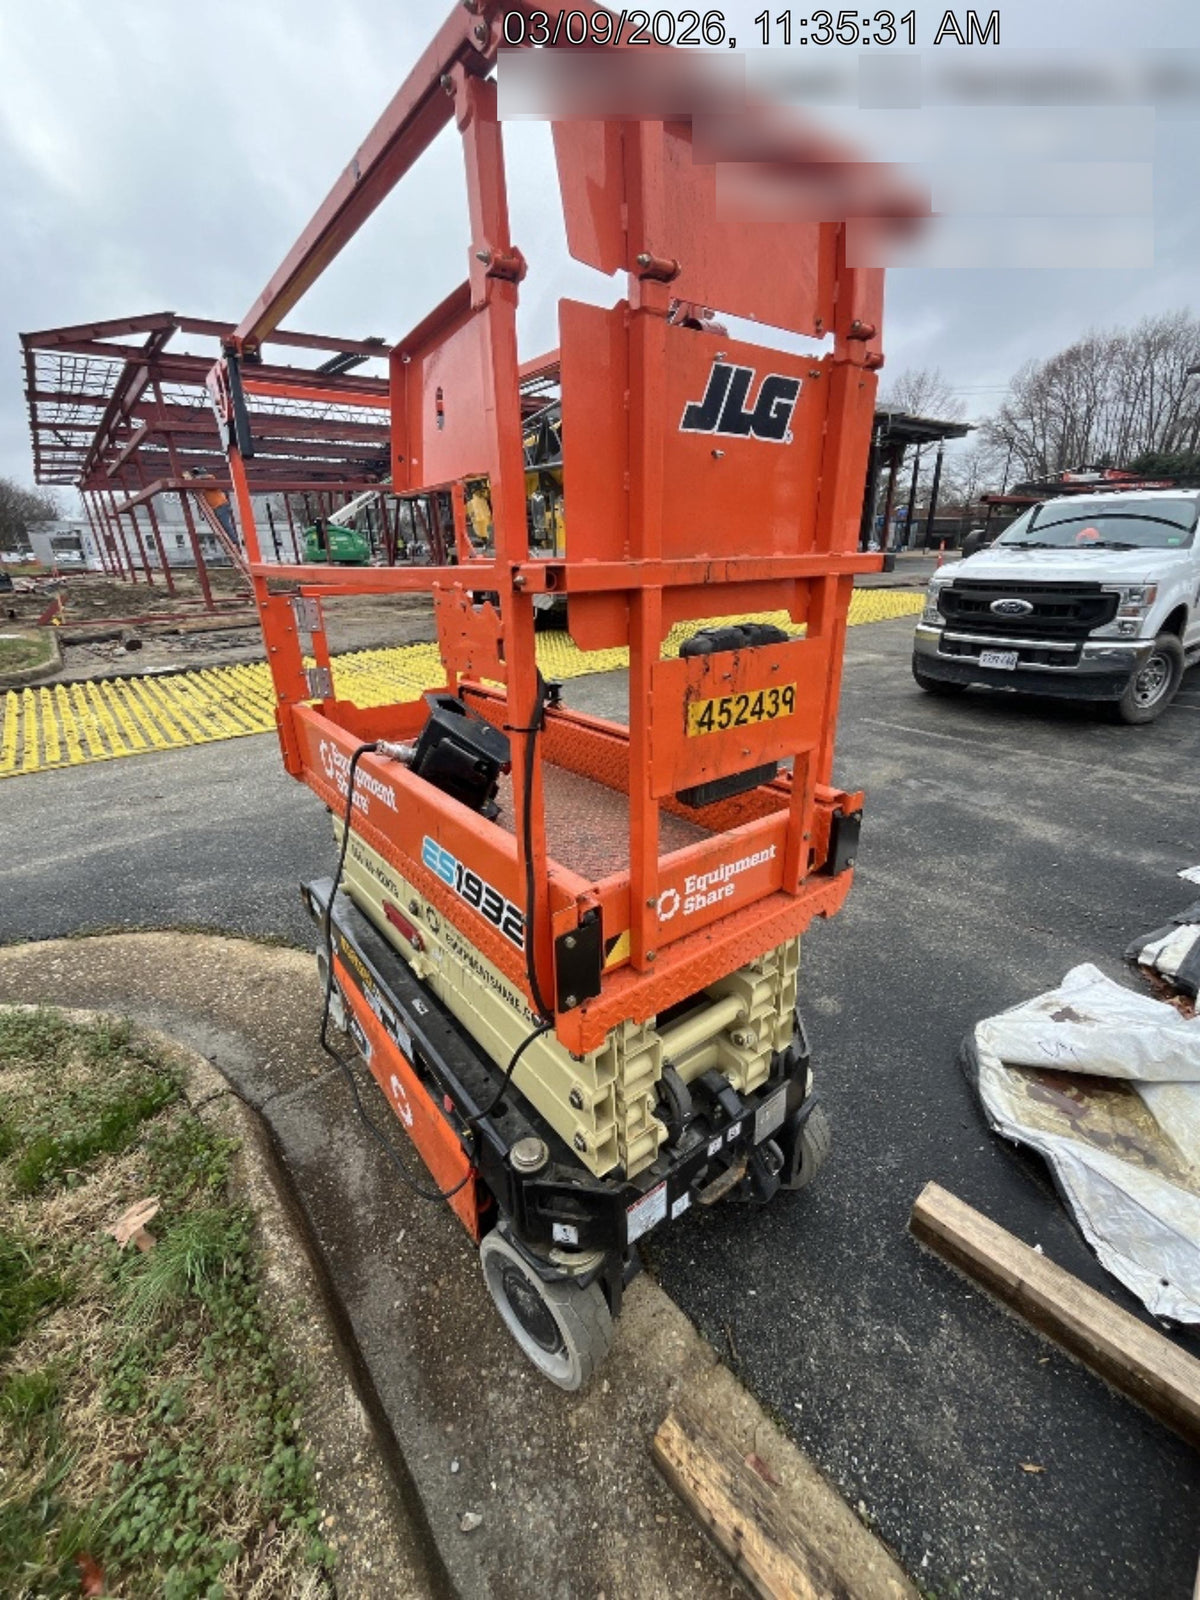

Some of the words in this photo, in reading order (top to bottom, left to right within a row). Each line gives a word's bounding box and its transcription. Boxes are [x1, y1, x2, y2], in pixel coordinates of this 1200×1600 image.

[679, 361, 802, 444] JLG
[698, 685, 795, 732] 452439
[684, 844, 777, 893] Equipment
[421, 835, 526, 952] ES1932
[683, 883, 735, 914] Share
